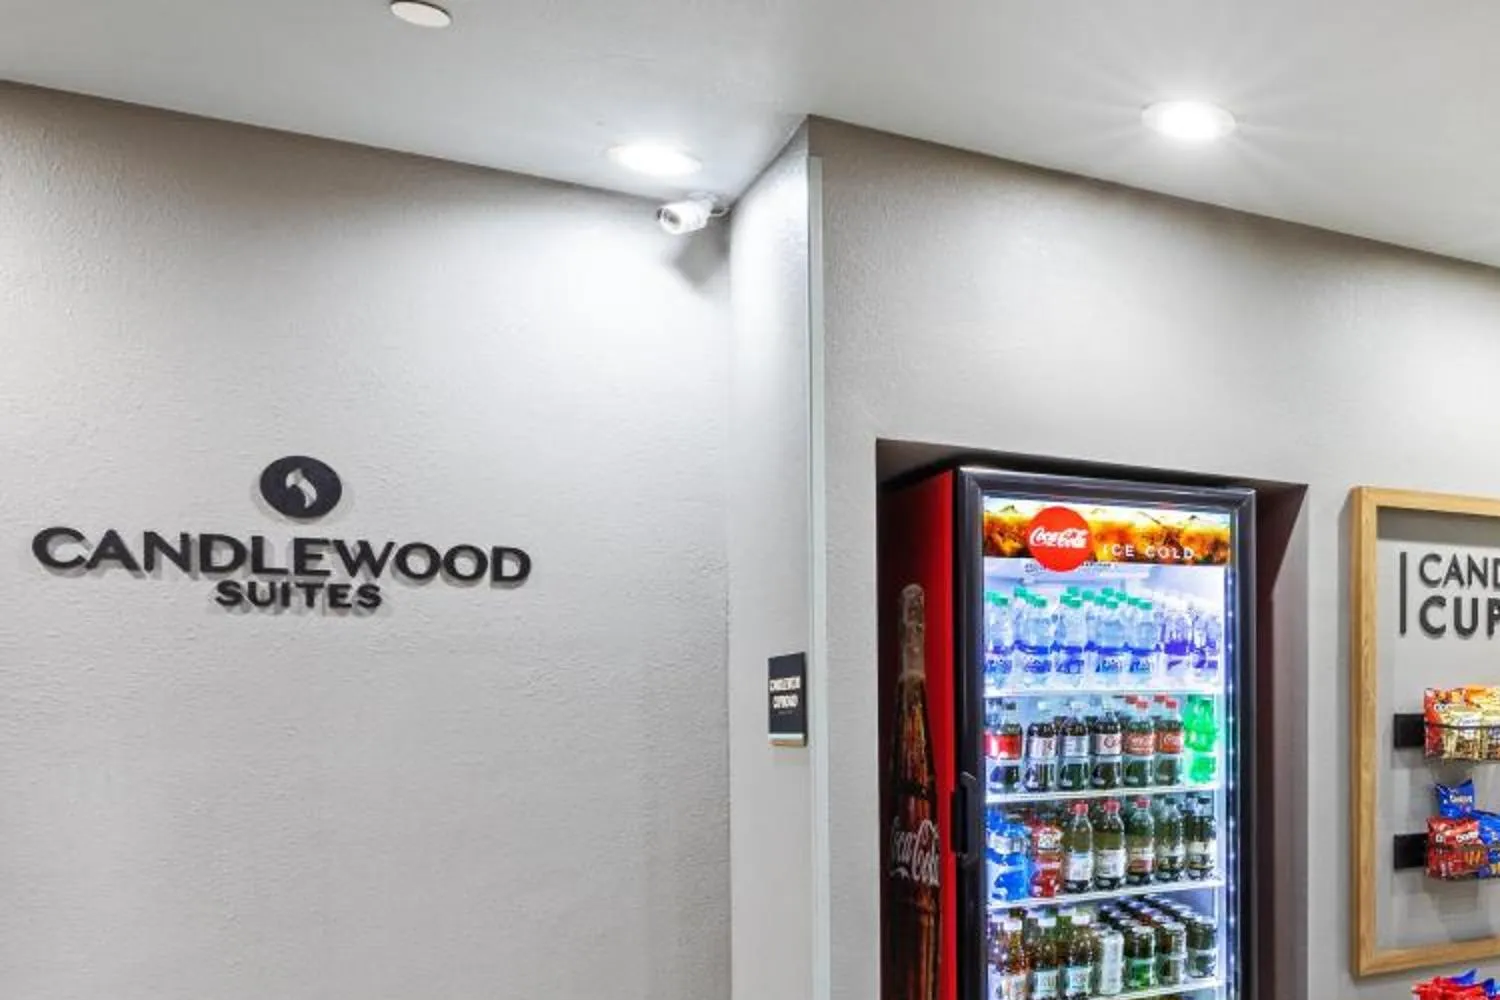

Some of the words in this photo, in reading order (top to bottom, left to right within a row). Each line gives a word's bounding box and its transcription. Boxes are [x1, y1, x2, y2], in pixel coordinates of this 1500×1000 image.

[32, 526, 532, 586] CANDLEWOOD
[1102, 543, 1135, 557] ICE
[1145, 545, 1195, 559] COLD
[215, 580, 383, 610] SUITES
